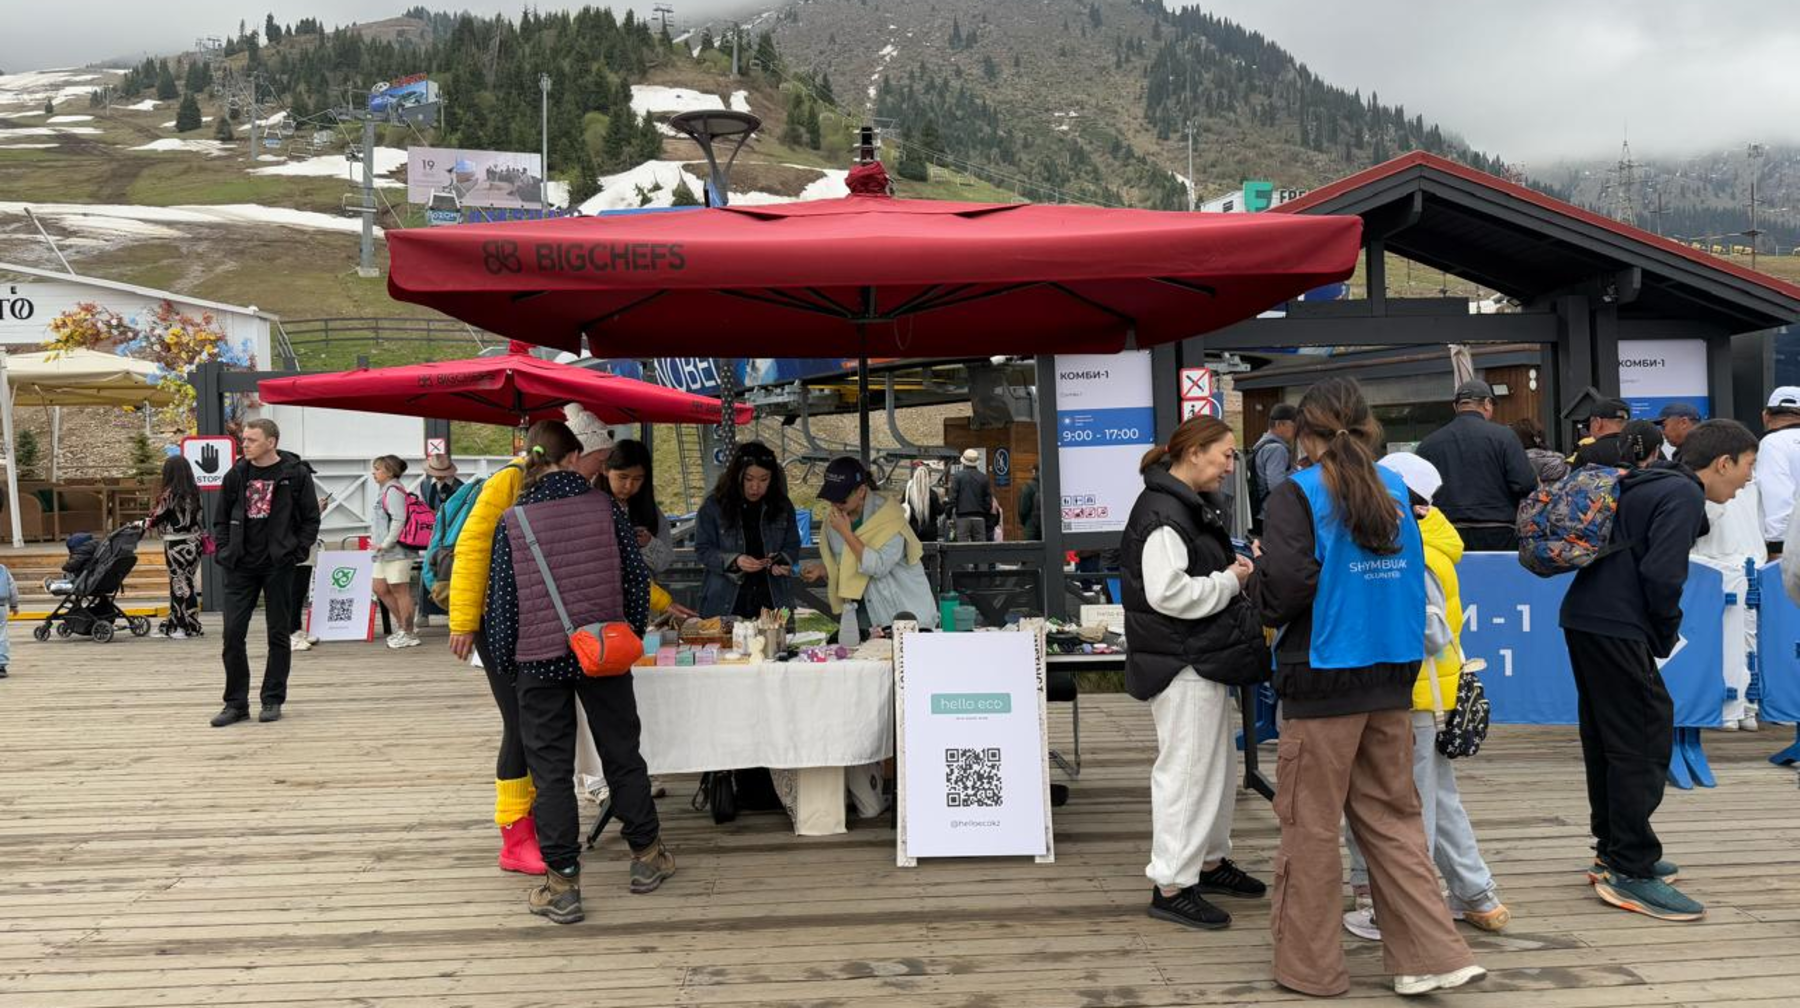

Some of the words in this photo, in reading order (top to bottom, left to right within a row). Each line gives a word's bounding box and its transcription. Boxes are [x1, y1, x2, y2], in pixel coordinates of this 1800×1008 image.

[421, 159, 435, 171] 19
[535, 242, 686, 273] BIGCHEFS
[1059, 369, 1109, 381] КОМБИ-1
[1062, 430, 1092, 442] 9:00
[1104, 428, 1139, 441] 17:00
[1516, 604, 1531, 632] 1
[940, 697, 974, 710] hello
[978, 698, 1003, 710] eco
